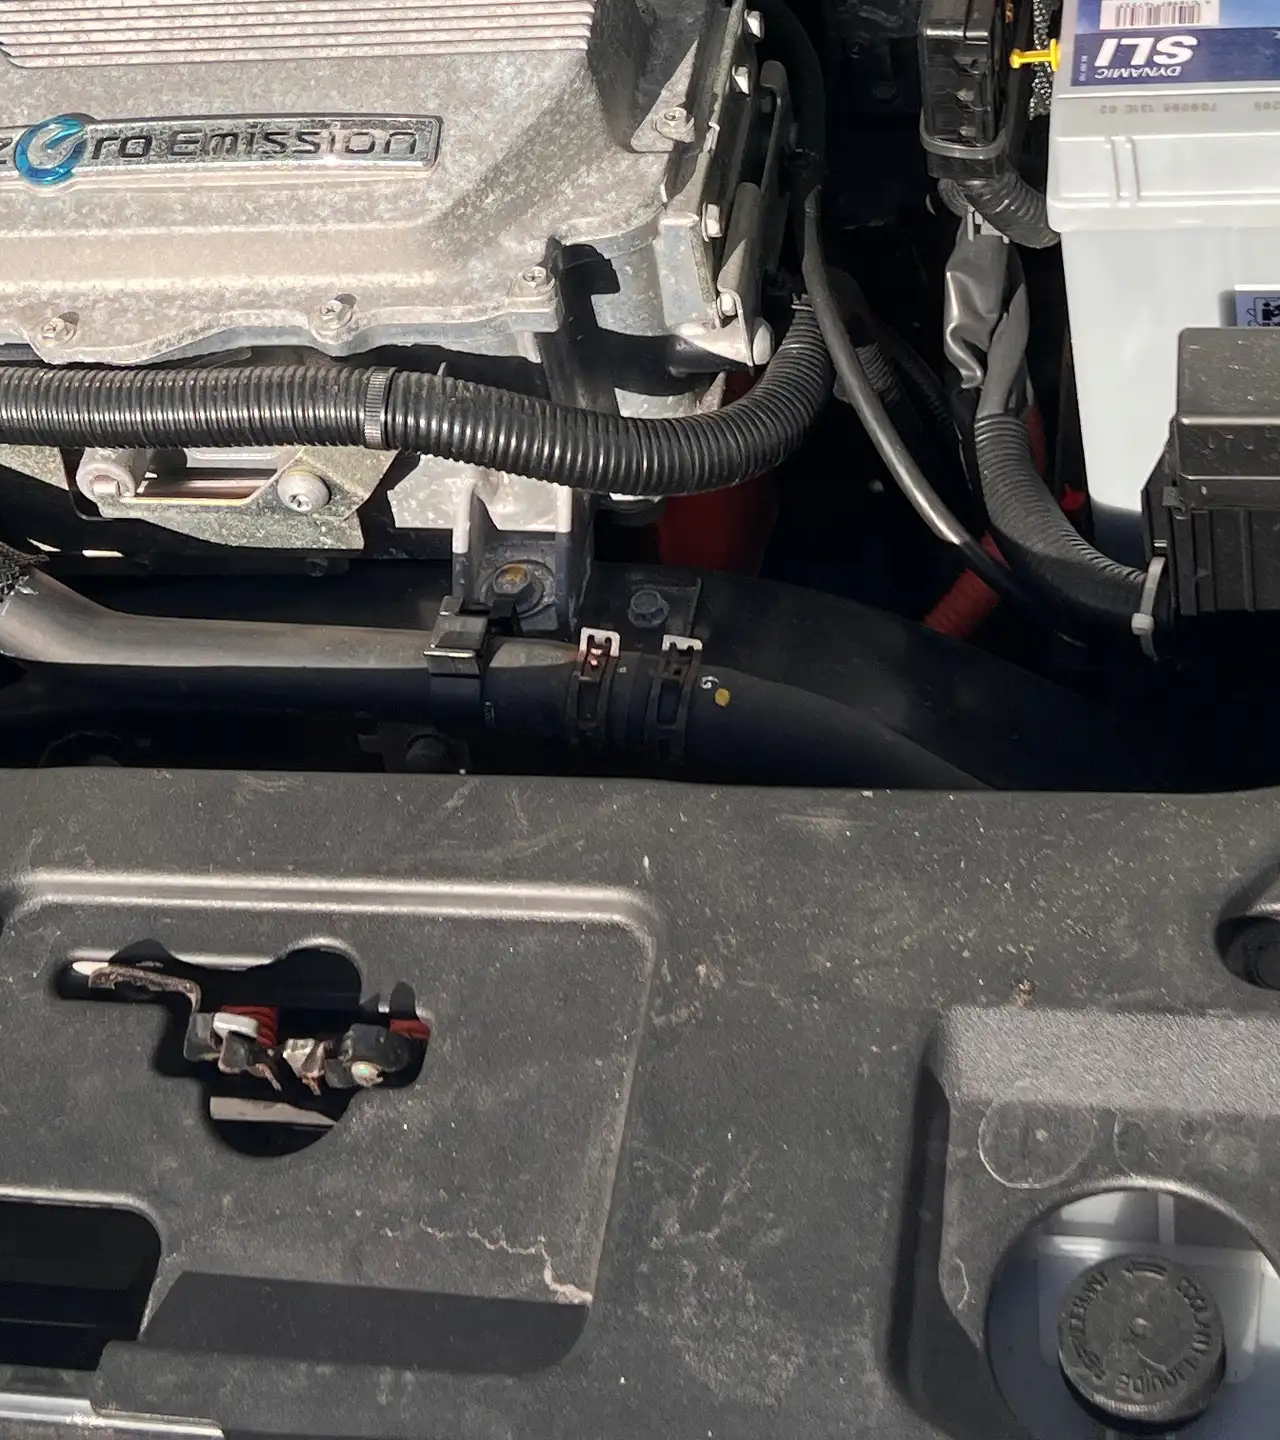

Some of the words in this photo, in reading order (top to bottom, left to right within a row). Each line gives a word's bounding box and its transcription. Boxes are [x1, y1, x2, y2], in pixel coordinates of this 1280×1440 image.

[1094, 35, 1198, 67] SLI
[1094, 66, 1183, 79] DYNAMIC
[168, 124, 418, 157] Emission
